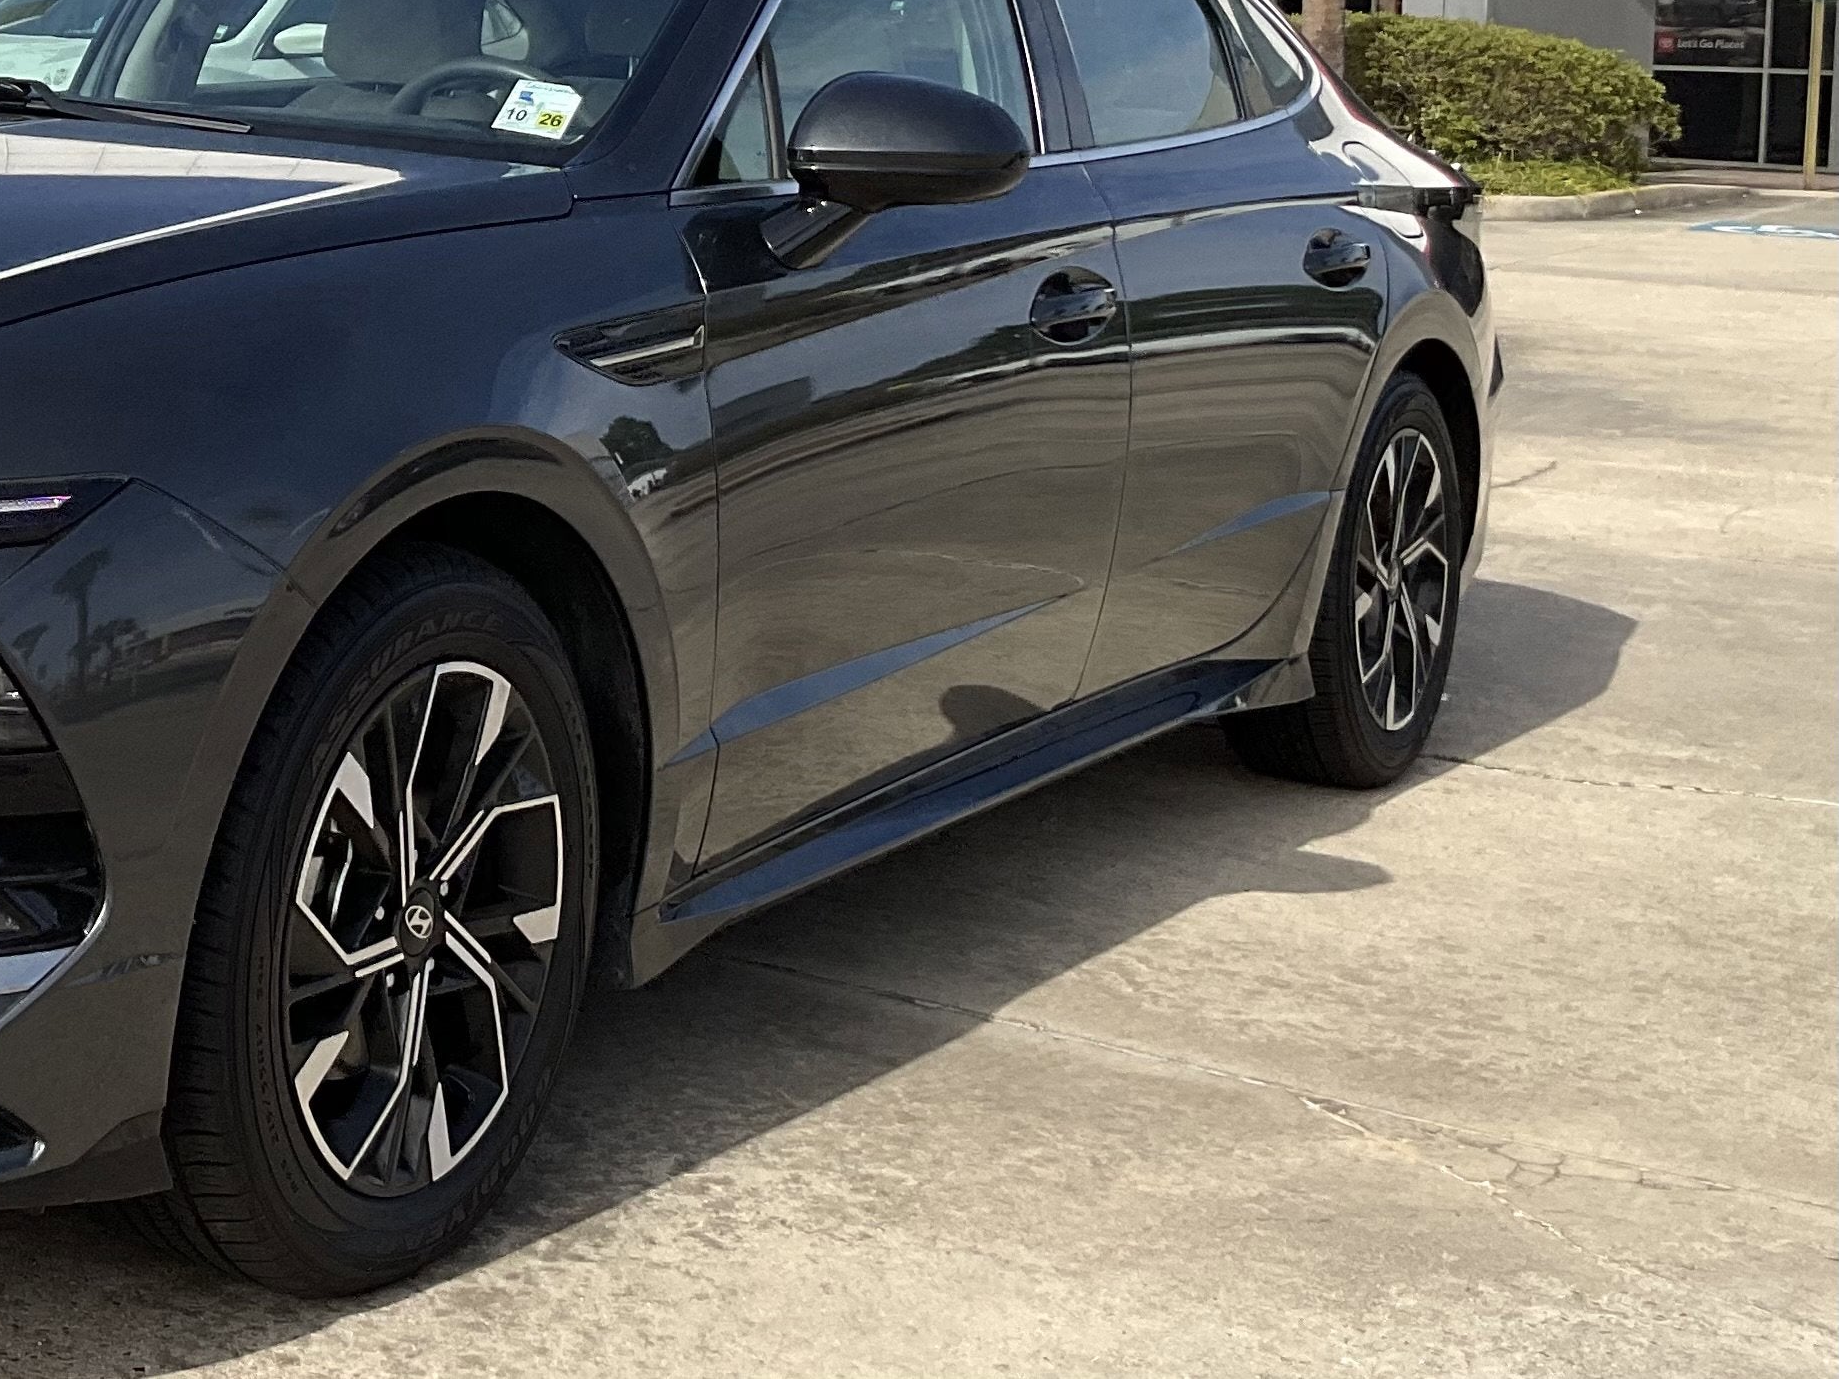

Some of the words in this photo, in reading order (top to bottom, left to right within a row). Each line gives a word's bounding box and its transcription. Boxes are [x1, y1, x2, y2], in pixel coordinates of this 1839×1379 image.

[1699, 38, 1714, 48] Go
[506, 107, 528, 121] 10
[538, 113, 564, 127] 26
